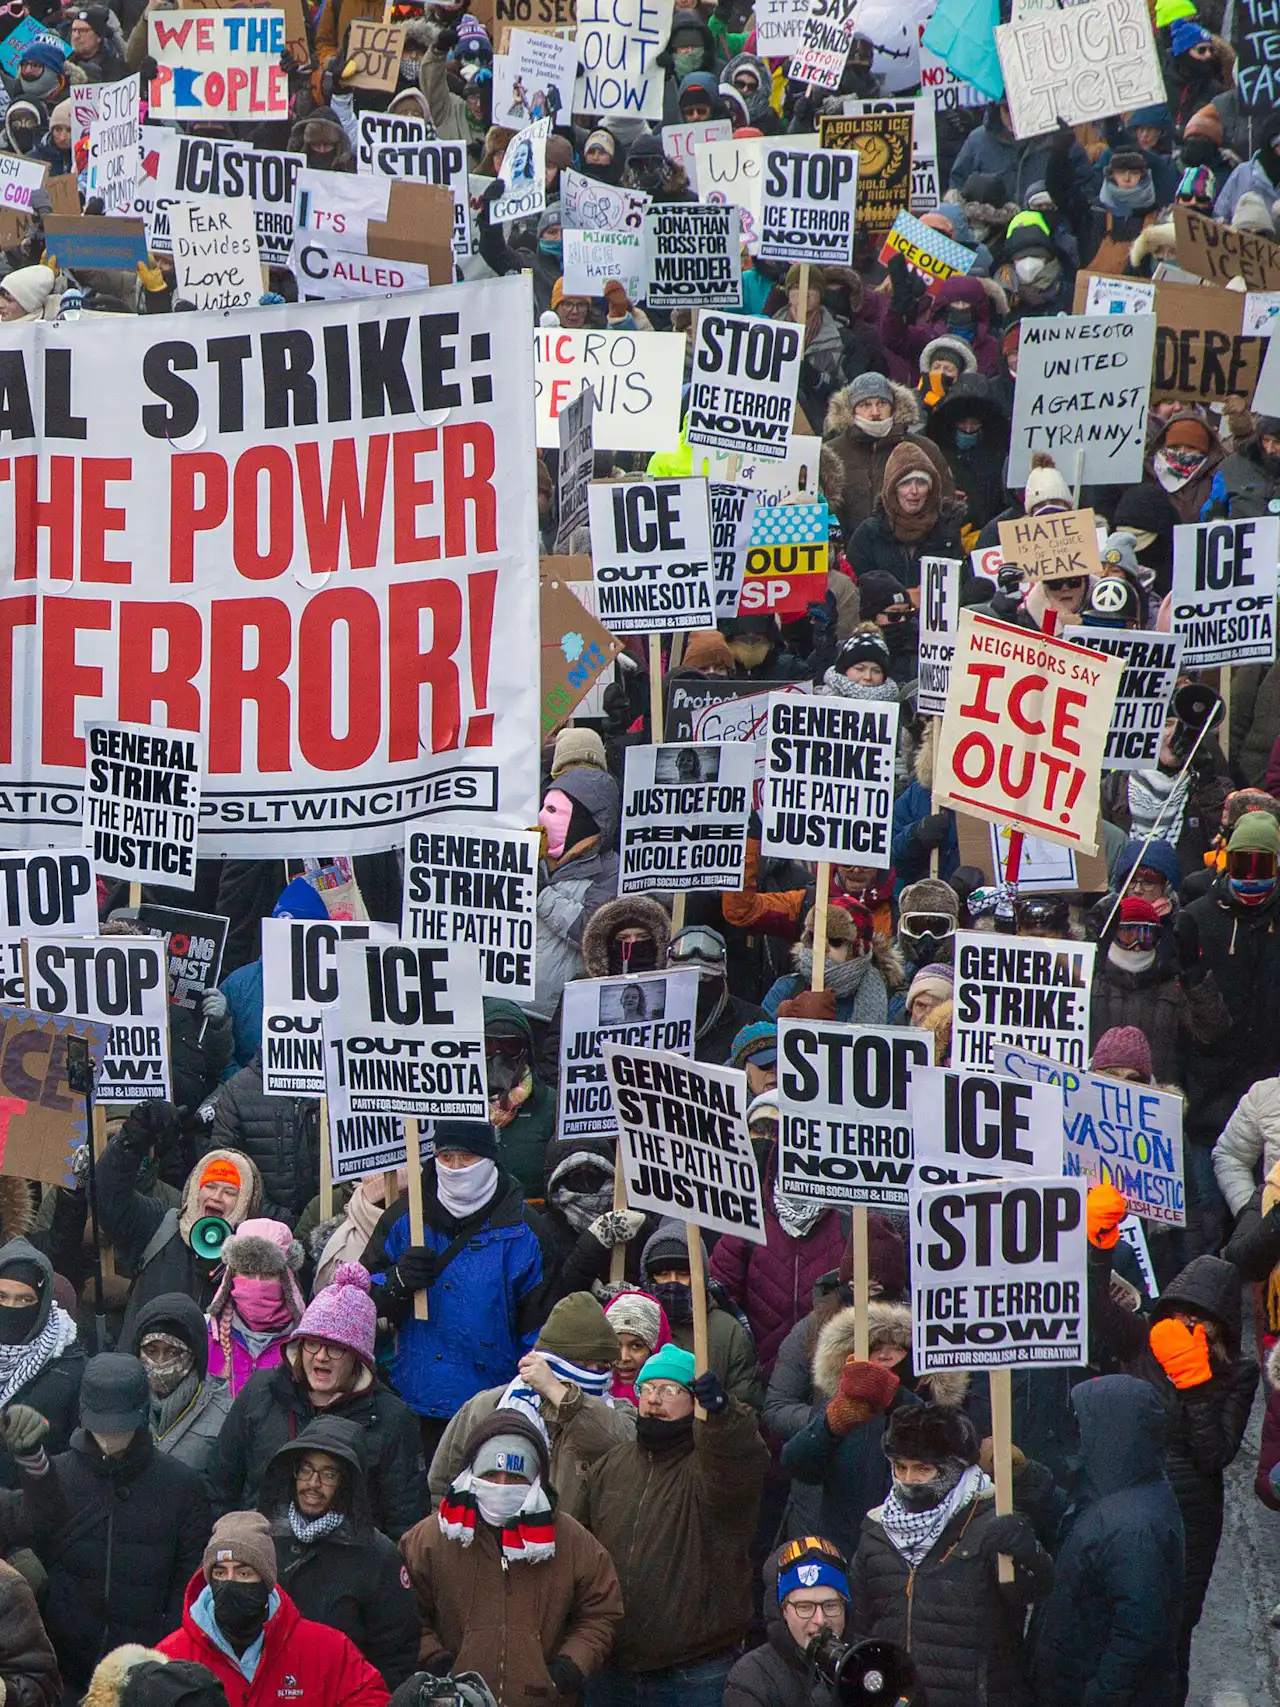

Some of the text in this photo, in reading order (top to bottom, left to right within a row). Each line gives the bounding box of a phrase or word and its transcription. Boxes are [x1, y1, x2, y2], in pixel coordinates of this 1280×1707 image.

[154, 19, 214, 51] WE
[223, 18, 285, 53] THE
[580, 0, 660, 34] ICE
[355, 25, 402, 52] ICE
[527, 38, 564, 53] Justice by
[532, 50, 556, 60] way of
[583, 31, 660, 74] OUT
[1013, 0, 1146, 82] FUCK
[354, 51, 399, 81] OUT
[922, 67, 944, 86] NO
[102, 78, 137, 121] STOP
[583, 75, 649, 112] NOW
[1031, 55, 1154, 130] ICE
[826, 118, 909, 134] ABOLISH ICE
[765, 150, 853, 201] STOP
[188, 206, 233, 233] FEAR
[493, 192, 543, 219] GOOD
[646, 205, 735, 216] ARREST
[653, 216, 730, 235] JONATHAN
[763, 206, 850, 232] ICE TERROR
[178, 236, 252, 258] Divides
[582, 231, 640, 247] MINNESOTA
[658, 235, 727, 254] ROSS FOR
[762, 230, 850, 248] NOW!
[893, 235, 958, 280] ICE OUT
[184, 266, 245, 288] Love
[300, 246, 405, 289] CALLED
[587, 264, 621, 278] HATES
[649, 280, 738, 294] NOW!
[655, 256, 732, 281] MURDER
[697, 315, 800, 384] STOP
[1043, 352, 1128, 379] UNITED
[141, 312, 494, 438] STRIKE:
[1031, 387, 1146, 416] AGAINST
[169, 421, 499, 584] POWER
[611, 484, 686, 554] ICE
[1015, 517, 1080, 544] HATE
[597, 562, 708, 583] OUT OF
[1023, 552, 1089, 580] WEAK
[1195, 522, 1256, 591] ICE
[598, 581, 711, 614] MINNESOTA
[970, 634, 1101, 688] NEIGHBORS SAY
[771, 703, 892, 745] GENERAL
[959, 663, 1088, 757] ICE
[89, 727, 198, 773] GENERAL
[770, 737, 891, 782] STRIKE:
[89, 758, 197, 809] STRIKE:
[951, 730, 1087, 824] OUT!
[625, 786, 746, 818] JUSTICE FOR
[769, 777, 890, 819] THE PATH TO
[625, 823, 744, 845] RENEE
[766, 811, 887, 854] JUSTICE
[409, 832, 533, 875] GENERAL
[623, 844, 742, 874] NICOLE GOOD
[408, 867, 533, 914] STRIKE:
[409, 906, 532, 950] THE PATH TO
[35, 944, 159, 1016] STOP
[364, 946, 454, 1026] ICE
[959, 945, 1086, 988] GENERAL
[958, 984, 1086, 1031] STRIKE:
[346, 1036, 481, 1058] OUT OF
[348, 1058, 483, 1096] MINNESOTA
[611, 1054, 742, 1121] GENERAL
[616, 1089, 749, 1156] STRIKE:
[944, 1074, 1035, 1166] ICE
[1091, 1080, 1161, 1135] THE
[623, 1126, 755, 1194] THE PATH TO
[630, 1163, 761, 1230] JUSTICE
[1098, 1157, 1184, 1210] DOMESTIC
[927, 1186, 1081, 1272] STOP
[925, 1280, 1080, 1321] ICE TERROR
[925, 1317, 1081, 1347] NOW!
[927, 1345, 1079, 1366] PARTY FOR SOCIALISM & LIBERATION
[506, 1454, 524, 1472] NBA
